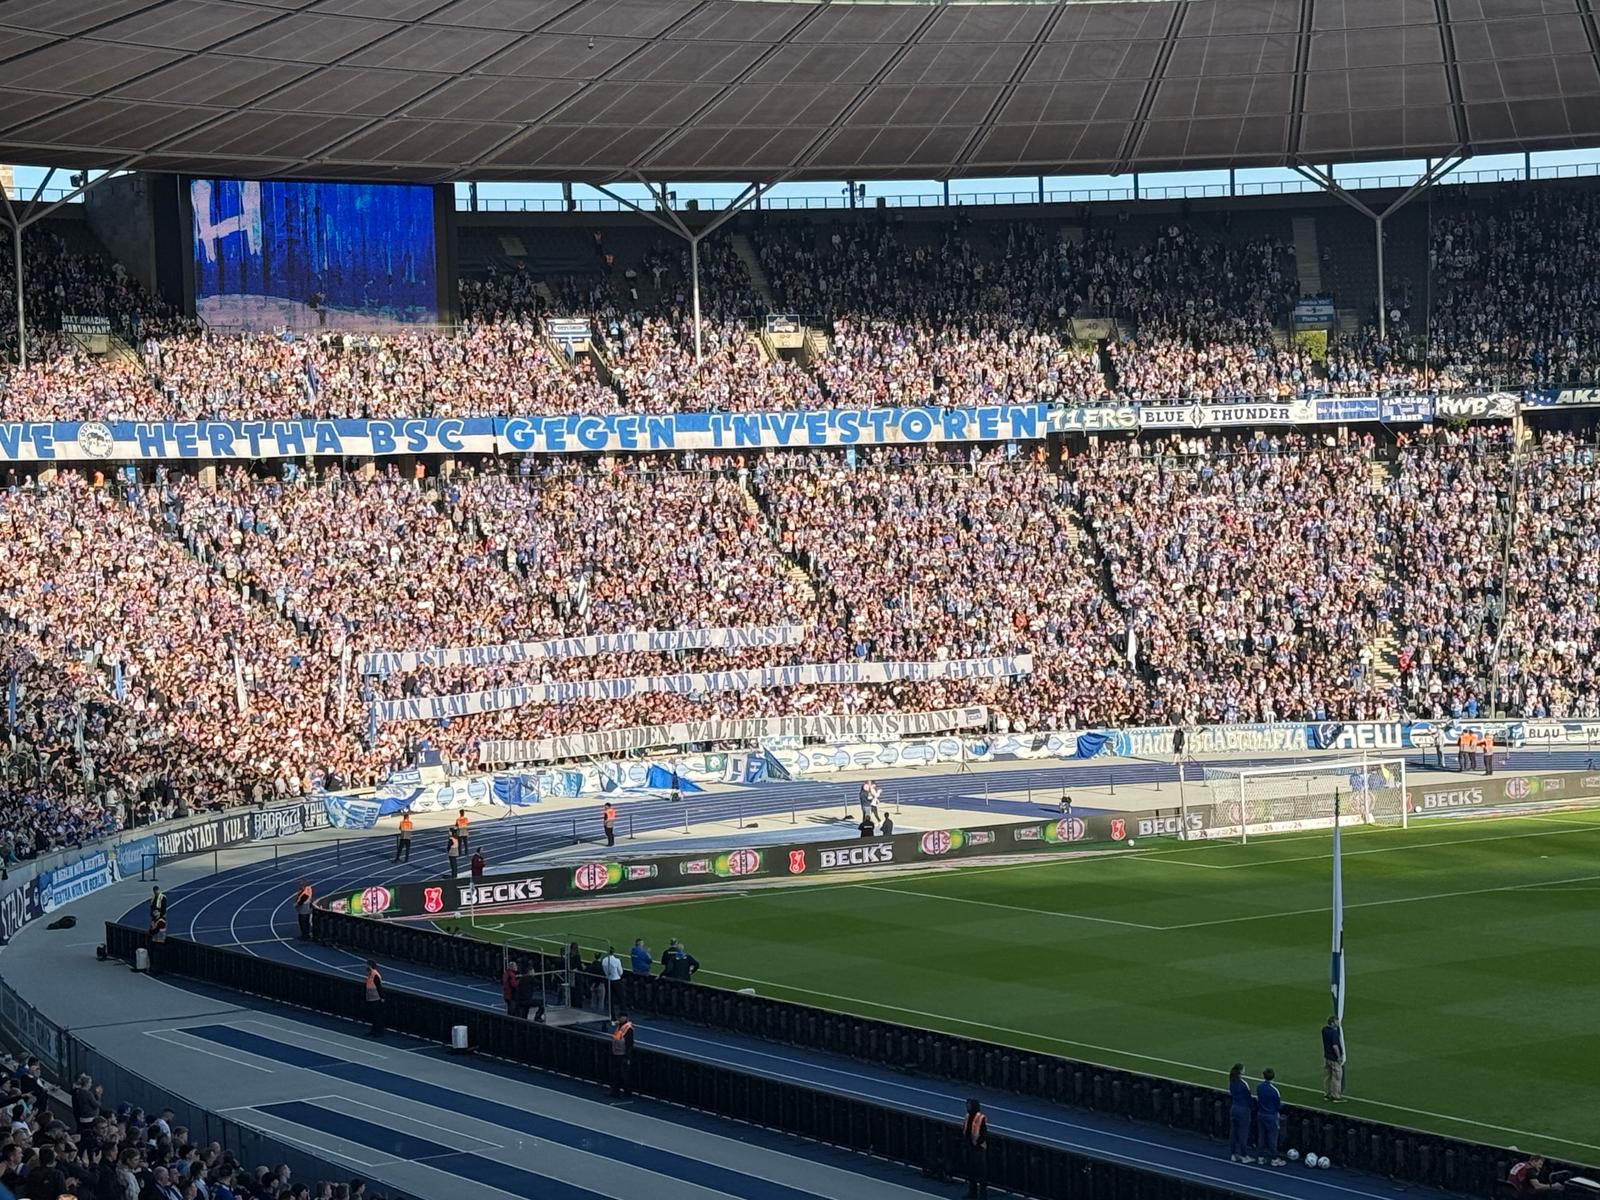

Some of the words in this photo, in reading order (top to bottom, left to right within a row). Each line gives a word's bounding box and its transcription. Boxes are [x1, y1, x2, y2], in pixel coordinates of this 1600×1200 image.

[504, 416, 677, 450] GEGEN
[708, 403, 1038, 447] INVESTOREN
[1145, 411, 1185, 422] BLUE
[1211, 408, 1290, 420] THUNDER
[136, 419, 342, 458] HERTHA
[368, 419, 464, 454] BSC
[363, 652, 404, 673] MAN
[415, 649, 447, 668] IST
[459, 645, 526, 667] FRECH
[543, 639, 586, 657] MAN
[596, 634, 637, 652] HAT
[648, 630, 713, 650] KEINE
[723, 626, 798, 647] ANGST.
[380, 700, 421, 720] MAN
[431, 694, 470, 716] HAT
[479, 687, 533, 711] GUTE
[545, 678, 637, 701] FREUNDE
[647, 675, 692, 693] UND
[703, 671, 750, 691] MAN
[761, 667, 804, 688] HAT
[882, 661, 930, 681] VIEL
[485, 740, 541, 763] RUHE
[553, 735, 577, 757] IN
[686, 718, 769, 742] WALTER
[779, 710, 960, 737] FRANKENSTEIN!
[1529, 728, 1560, 738] BLAU
[1424, 788, 1483, 809] BECK'S
[157, 822, 219, 855] HAUPTSTADT
[223, 815, 250, 843] KULT
[1138, 813, 1203, 835] BECK'S
[820, 843, 893, 868] BECK'S
[460, 878, 543, 905] BECK'S
